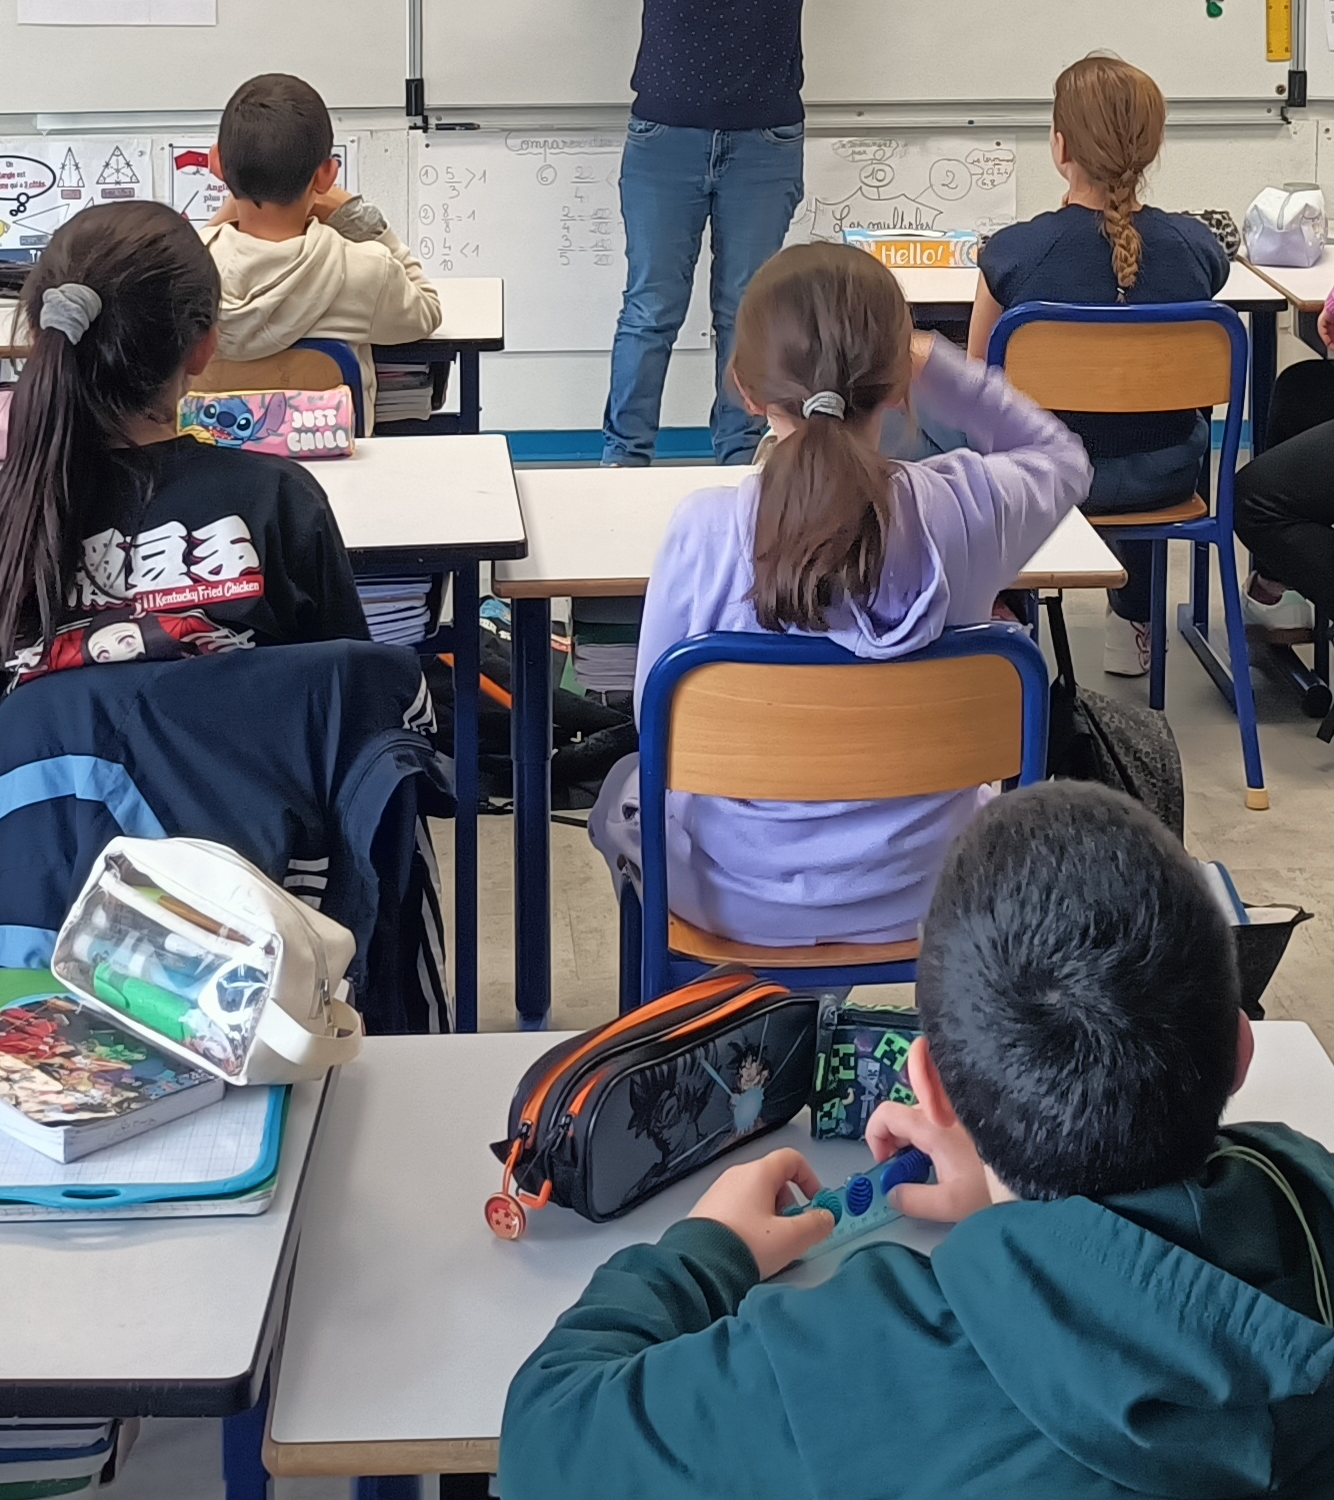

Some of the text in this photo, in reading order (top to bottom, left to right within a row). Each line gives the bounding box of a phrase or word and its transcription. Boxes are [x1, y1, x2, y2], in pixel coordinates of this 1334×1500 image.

[864, 167, 886, 182] 10
[941, 169, 958, 190] 2
[203, 193, 220, 203] plus
[881, 242, 943, 266] Hello!
[292, 408, 337, 429] JUST
[287, 429, 349, 452] CHILL
[155, 581, 260, 608] Kentucky Fried Chicken
